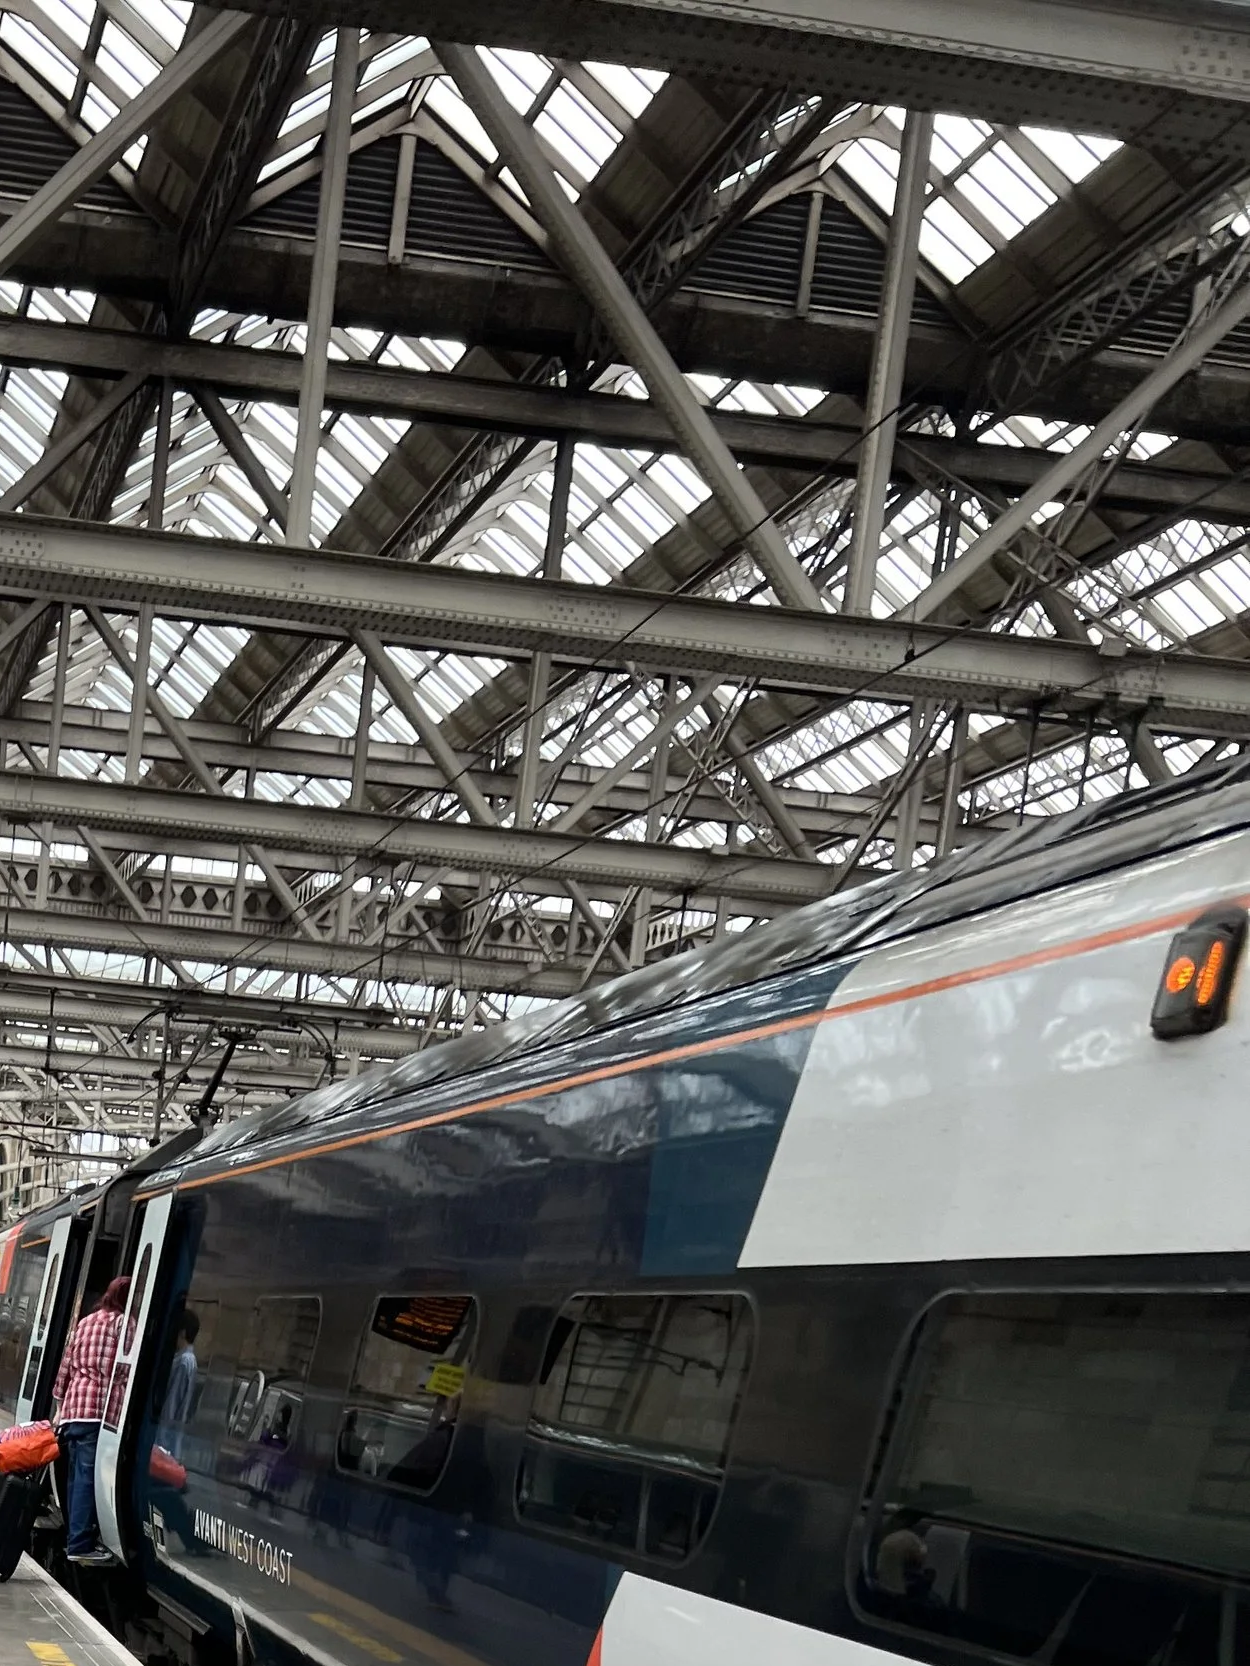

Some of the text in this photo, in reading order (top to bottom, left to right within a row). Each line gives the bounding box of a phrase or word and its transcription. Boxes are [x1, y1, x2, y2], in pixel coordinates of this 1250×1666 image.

[194, 1508, 226, 1552] AVANTI
[228, 1524, 255, 1566] WEST
[257, 1538, 294, 1586] COAST
